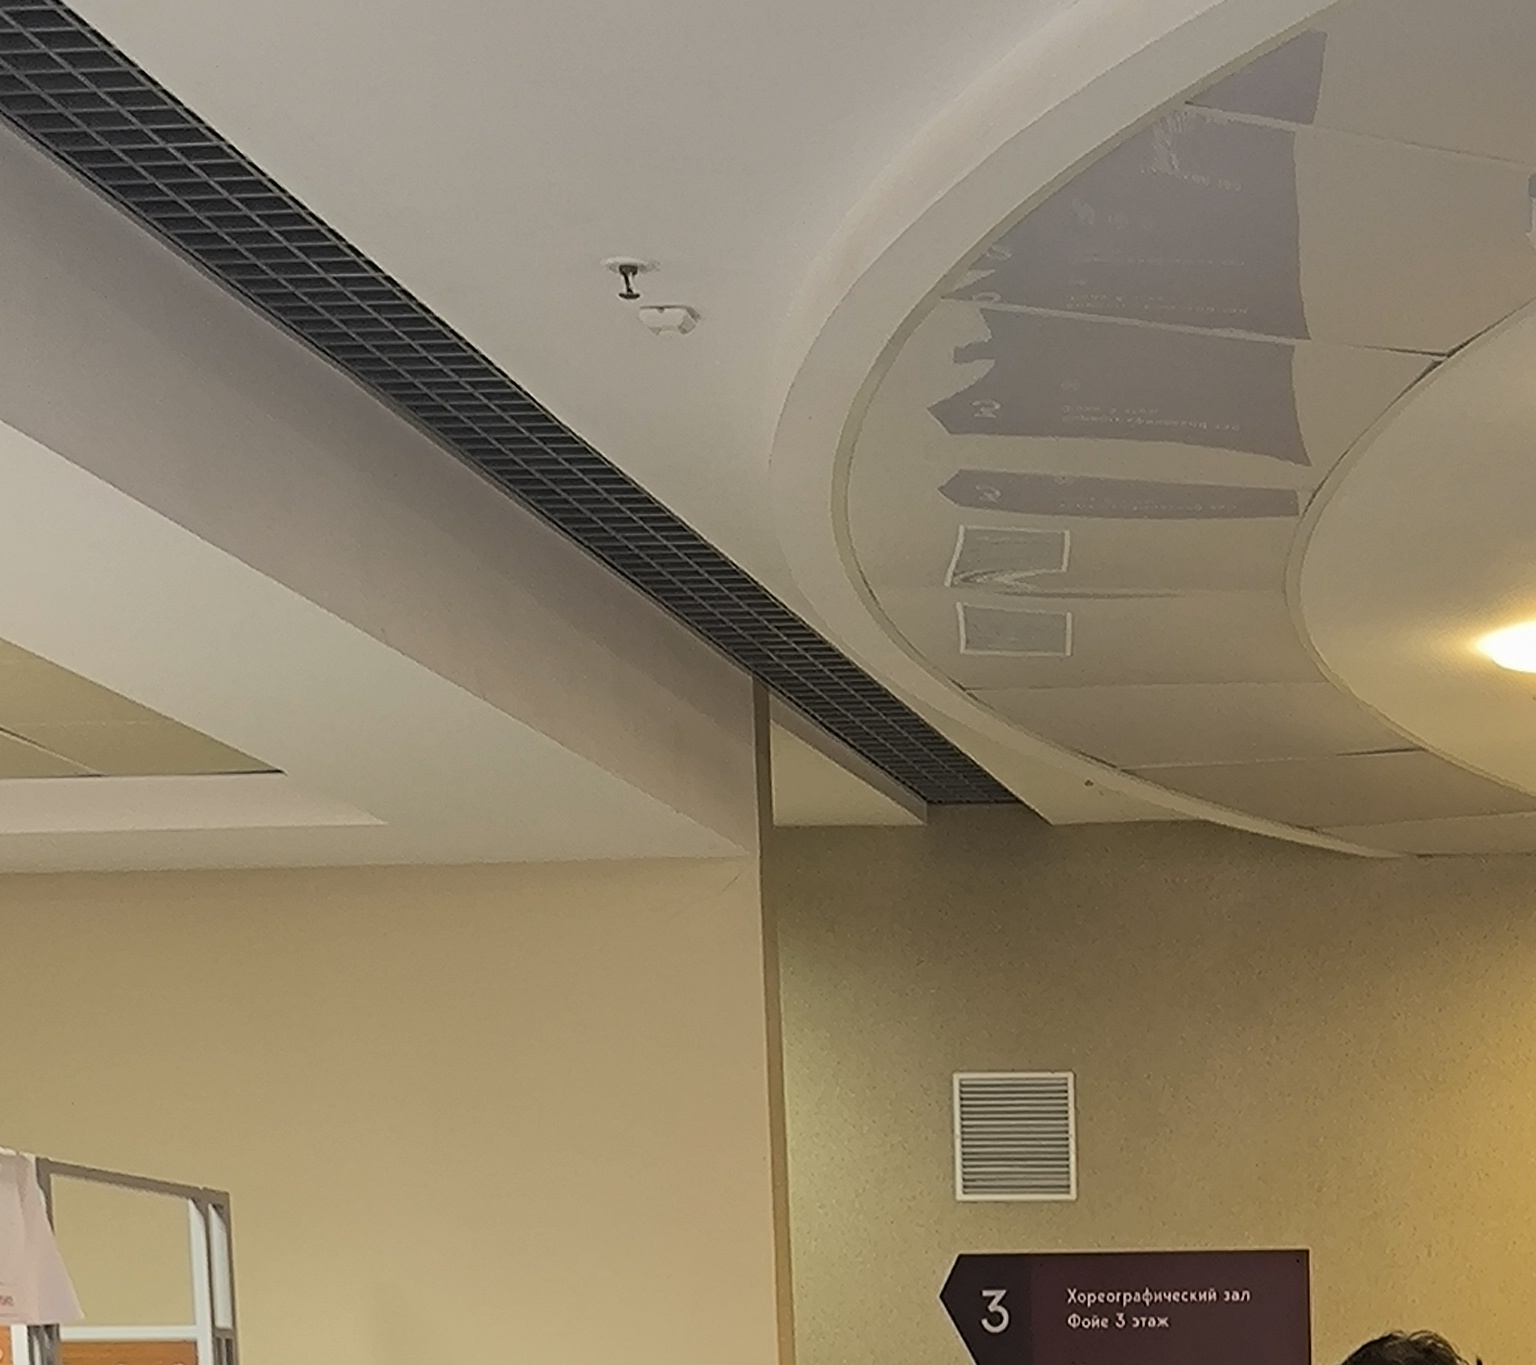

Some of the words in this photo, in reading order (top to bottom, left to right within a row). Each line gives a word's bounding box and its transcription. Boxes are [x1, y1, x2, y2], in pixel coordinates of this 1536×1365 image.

[1067, 1287, 1217, 1308] Хореографический
[1224, 1290, 1251, 1302] зал
[981, 1289, 1009, 1333] 3
[1067, 1312, 1109, 1329] Фойе
[1115, 1312, 1126, 1329] 3
[1132, 1316, 1169, 1328] этаж
